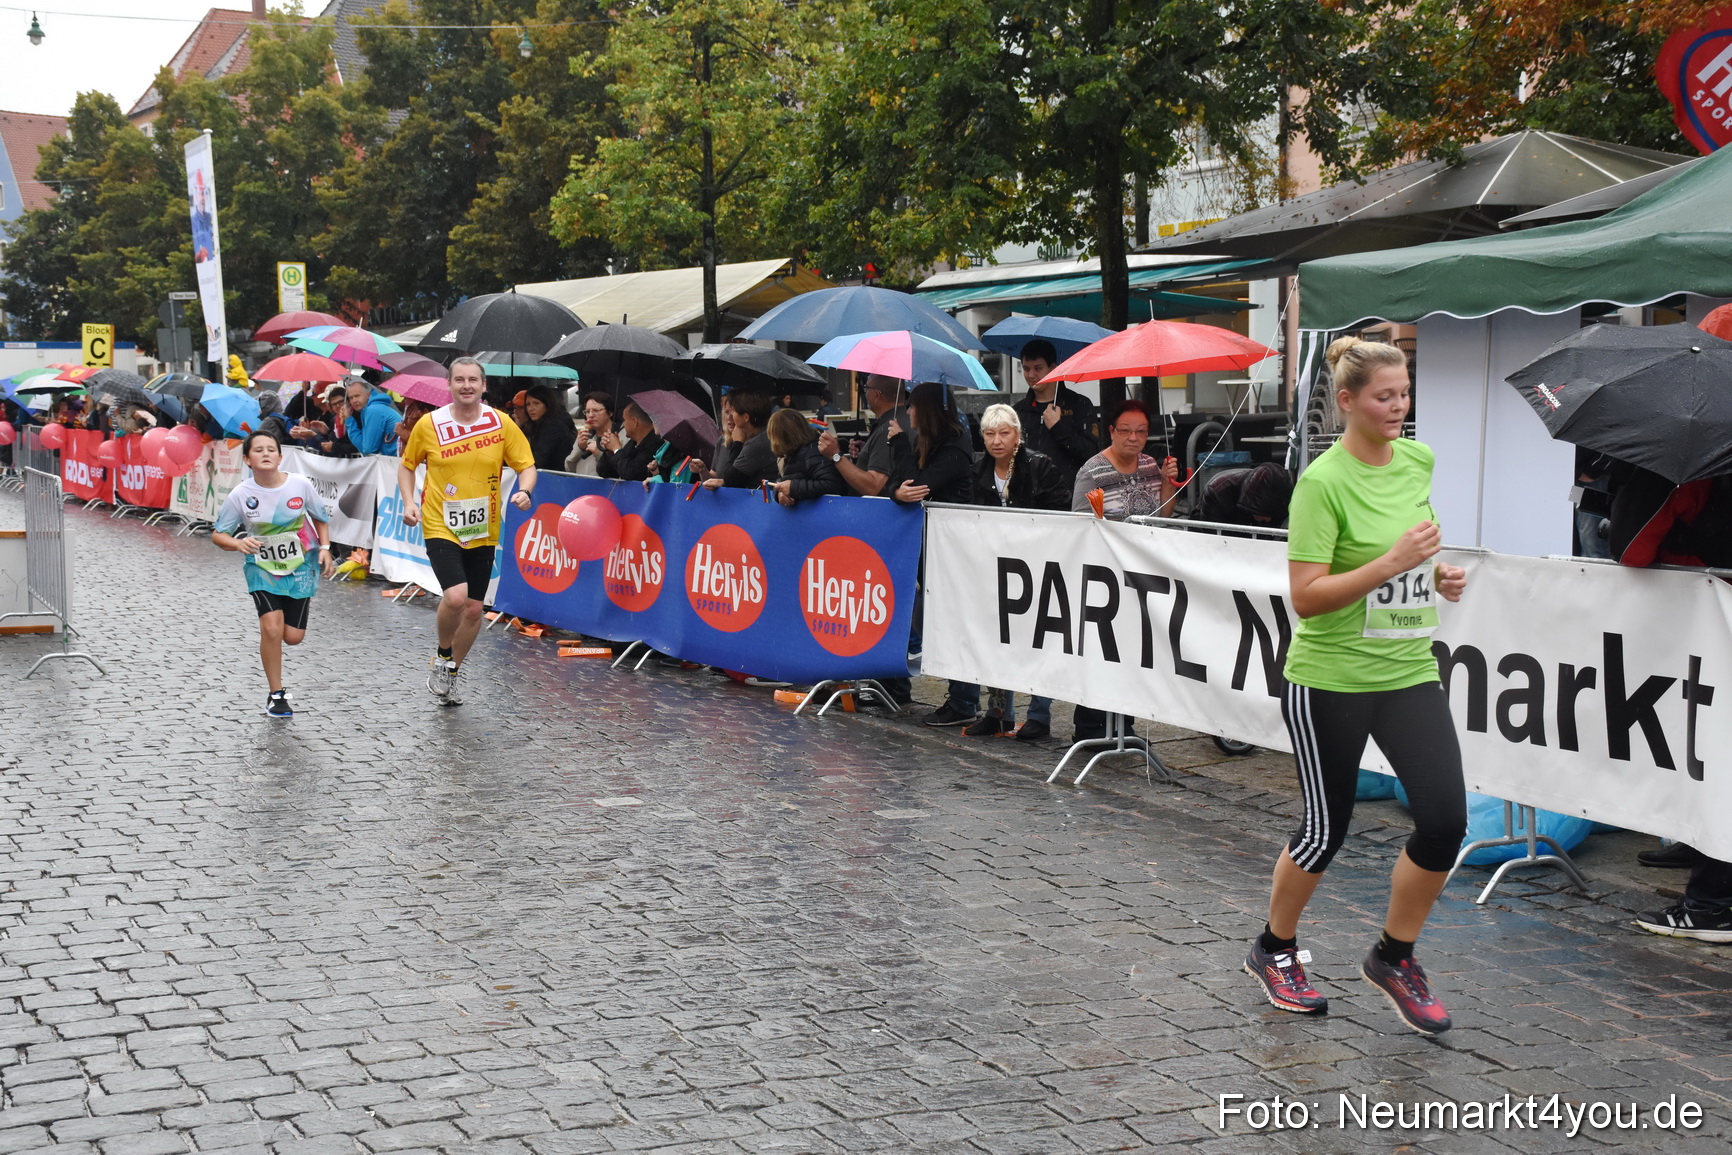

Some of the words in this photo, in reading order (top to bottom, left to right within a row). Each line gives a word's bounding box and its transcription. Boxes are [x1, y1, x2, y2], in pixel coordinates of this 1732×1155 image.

[86, 325, 111, 335] Block
[90, 337, 106, 359] C
[1538, 383, 1561, 408] BROADCOM
[441, 443, 472, 459] MAX
[474, 434, 505, 449] BÖGL
[449, 508, 485, 527] 5163
[455, 528, 480, 537] Christian
[259, 541, 298, 560] 5164
[522, 563, 555, 579] SPORTS
[606, 540, 662, 594] Hervis
[691, 543, 763, 612] Hervis
[606, 581, 636, 597] SPORTS
[807, 557, 887, 634] Hervis
[696, 598, 732, 615] SPORTS
[812, 618, 848, 637] SPORTS
[997, 556, 1207, 683] PARTL
